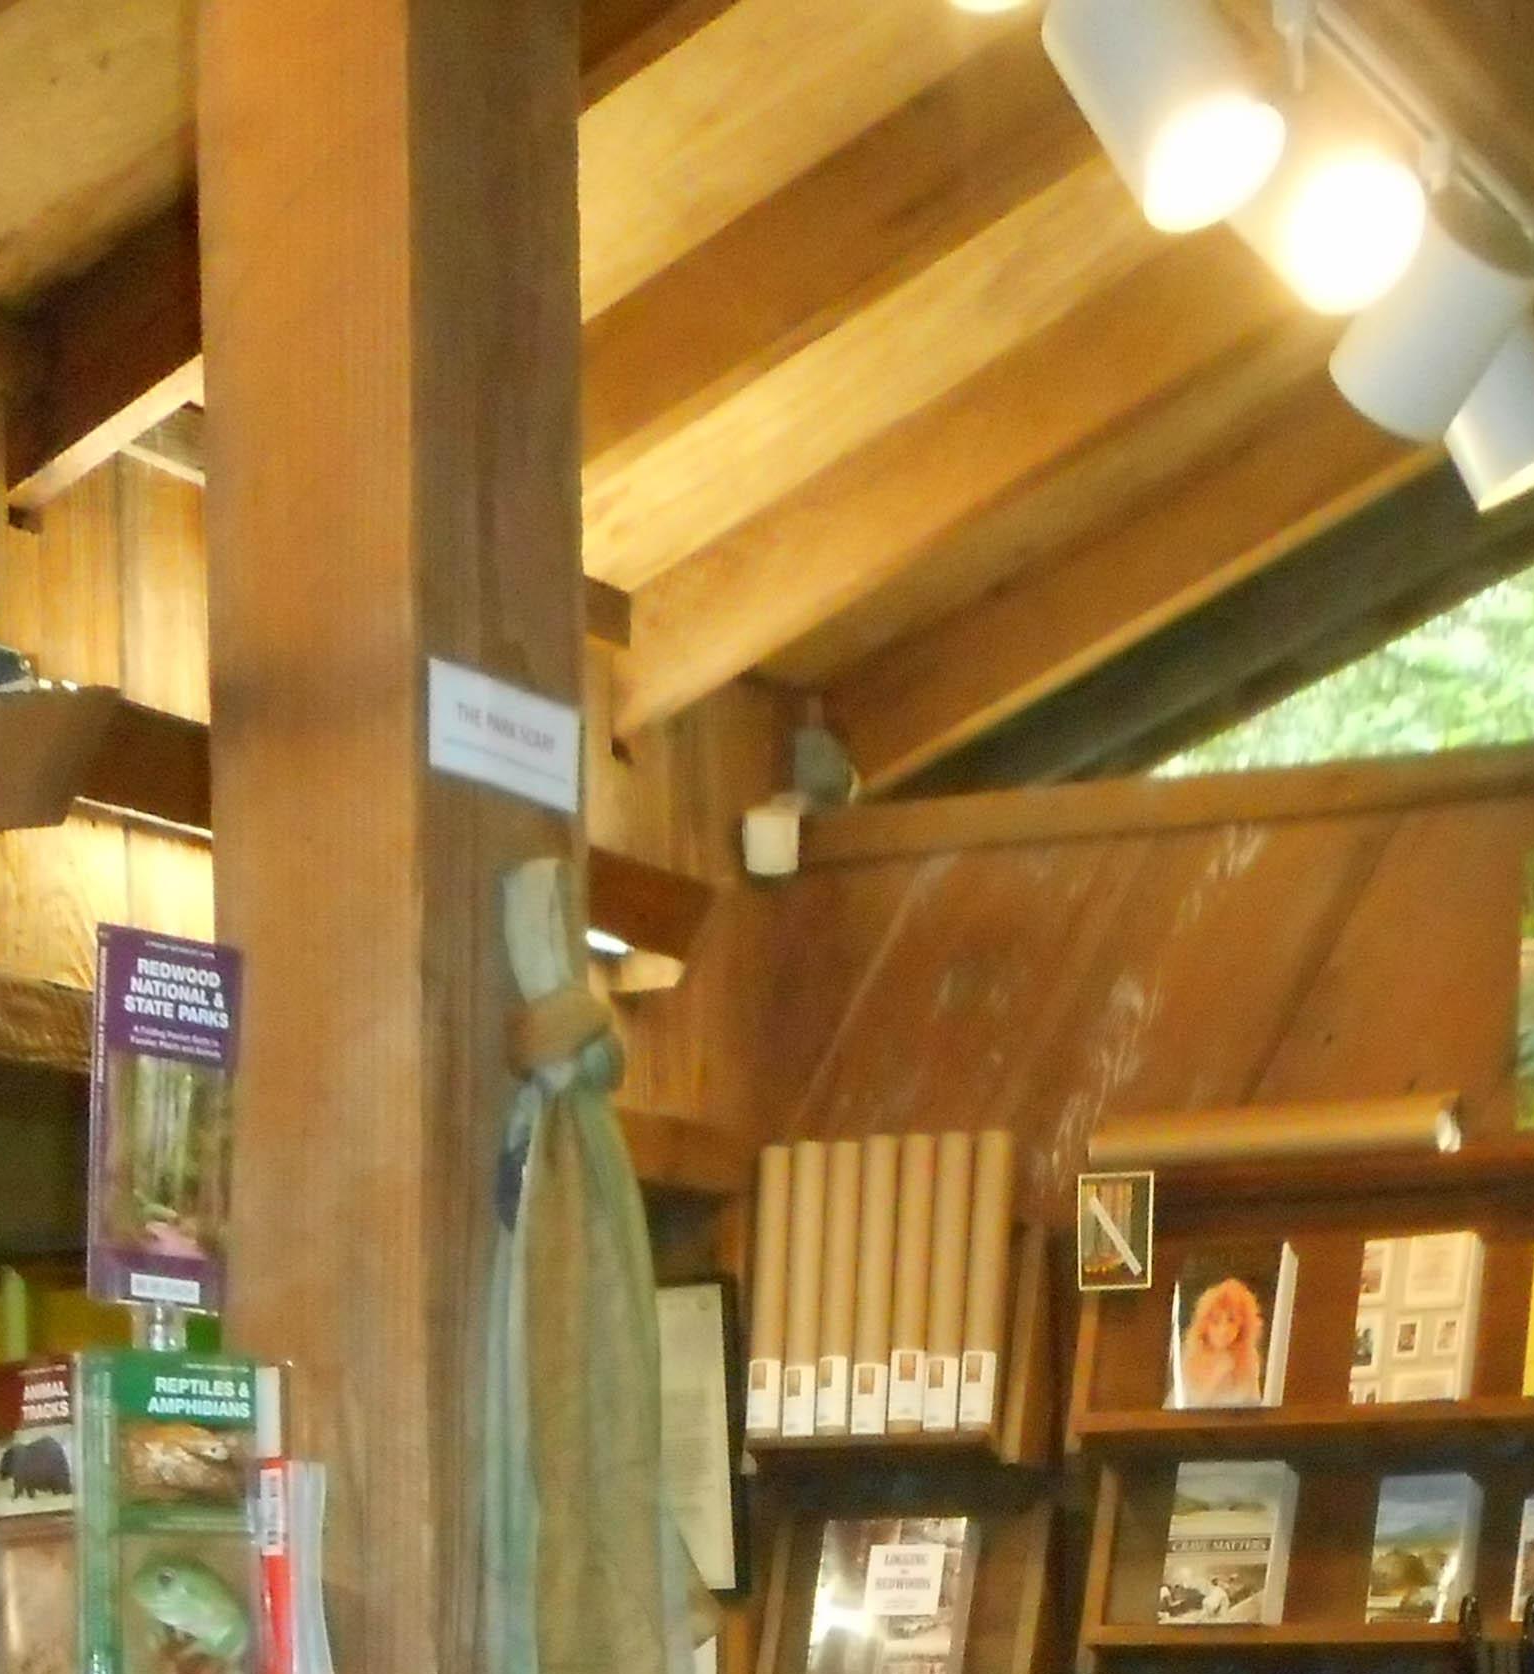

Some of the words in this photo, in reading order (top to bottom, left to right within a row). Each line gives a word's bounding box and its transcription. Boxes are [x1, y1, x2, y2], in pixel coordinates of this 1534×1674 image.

[136, 957, 221, 989] REDWOOD
[130, 976, 209, 1006] NATIONAL
[213, 992, 224, 1009] &
[124, 995, 174, 1019] STATE
[178, 1004, 229, 1029] PARKS
[154, 1377, 232, 1397] REPTILES
[236, 1378, 249, 1398] &
[147, 1401, 251, 1419] AMPHIBIANS
